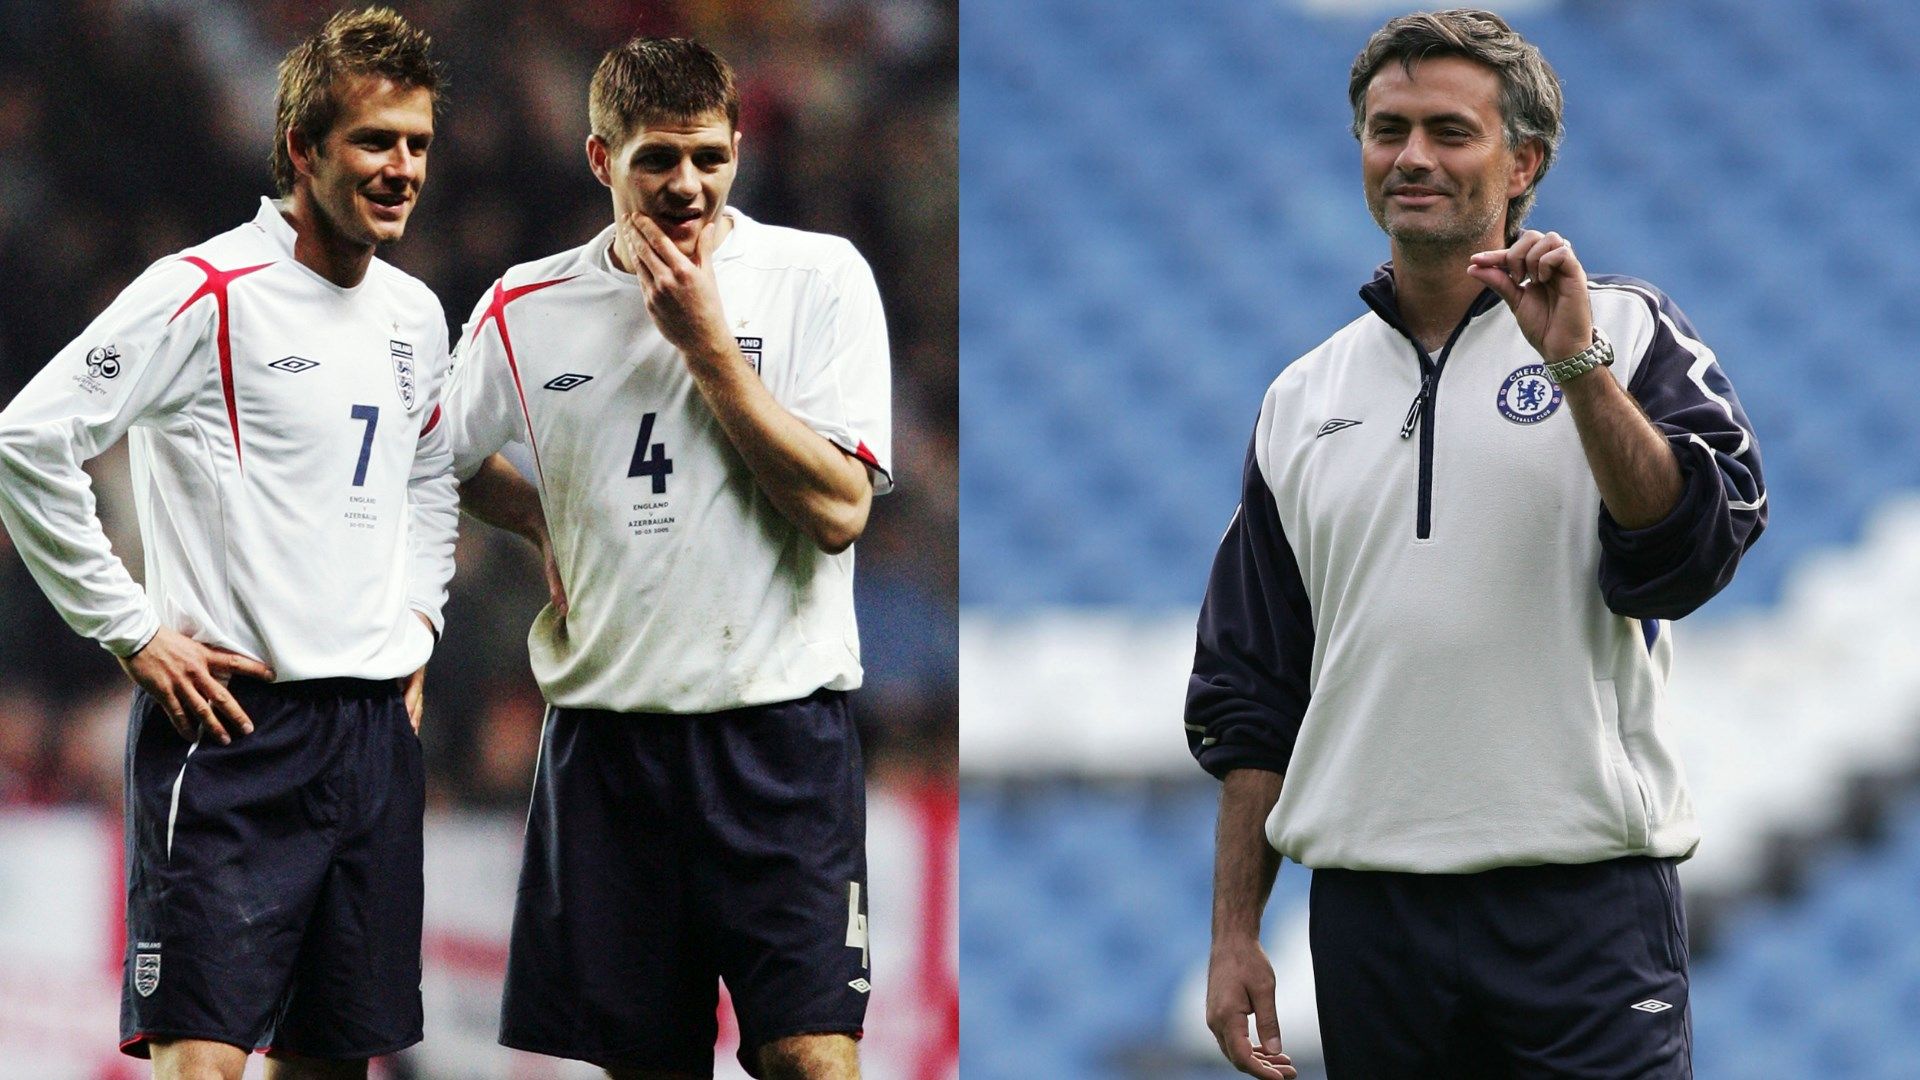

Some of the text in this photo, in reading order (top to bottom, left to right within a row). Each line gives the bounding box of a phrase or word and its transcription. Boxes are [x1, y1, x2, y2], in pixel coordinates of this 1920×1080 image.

[1509, 366, 1548, 382] CHELSE
[1505, 410, 1551, 422] FOOTBALL CLUB
[351, 404, 379, 486] 7
[627, 412, 673, 494] 4
[632, 501, 669, 511] ENGLAND
[628, 517, 675, 527] AZERBAIJAN
[845, 882, 868, 969] 4
